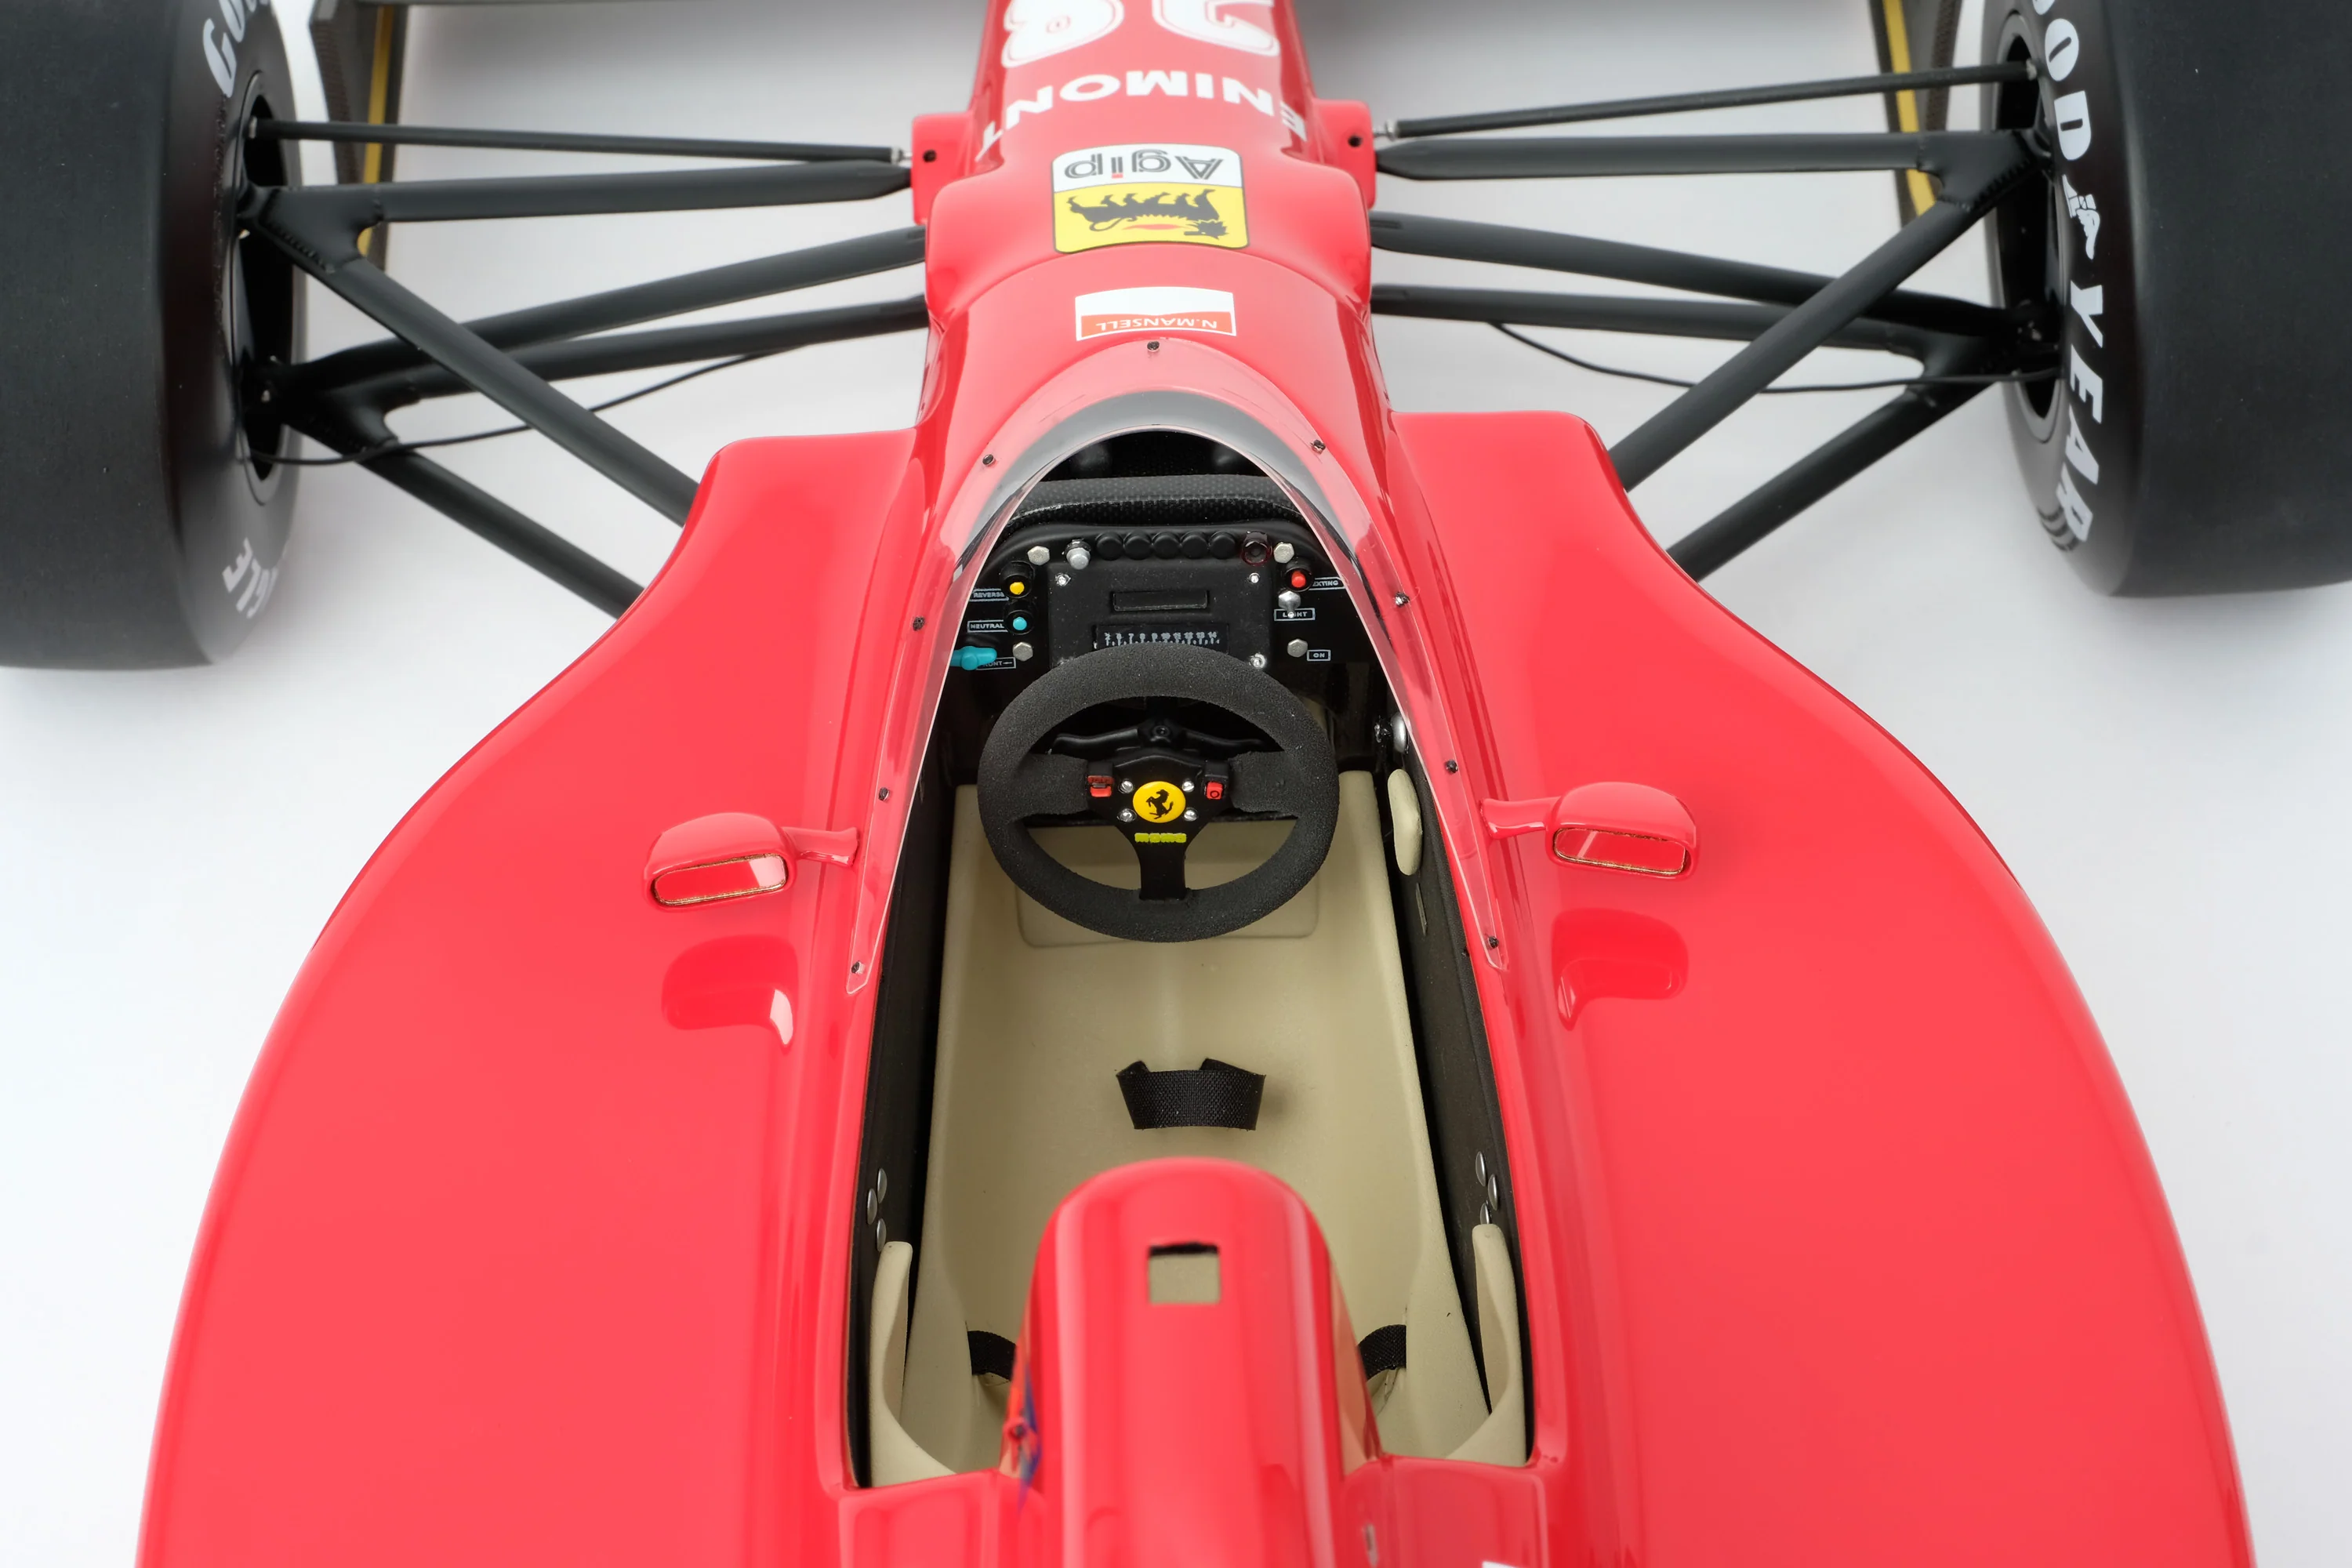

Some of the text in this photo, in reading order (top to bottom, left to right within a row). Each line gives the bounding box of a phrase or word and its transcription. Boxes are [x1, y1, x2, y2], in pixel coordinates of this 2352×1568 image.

[975, 71, 1307, 162] ENIMONT
[1065, 149, 1223, 180] Agip
[2032, 0, 2103, 542] OD YEAR
[1096, 318, 1217, 330] N.MANSELL
